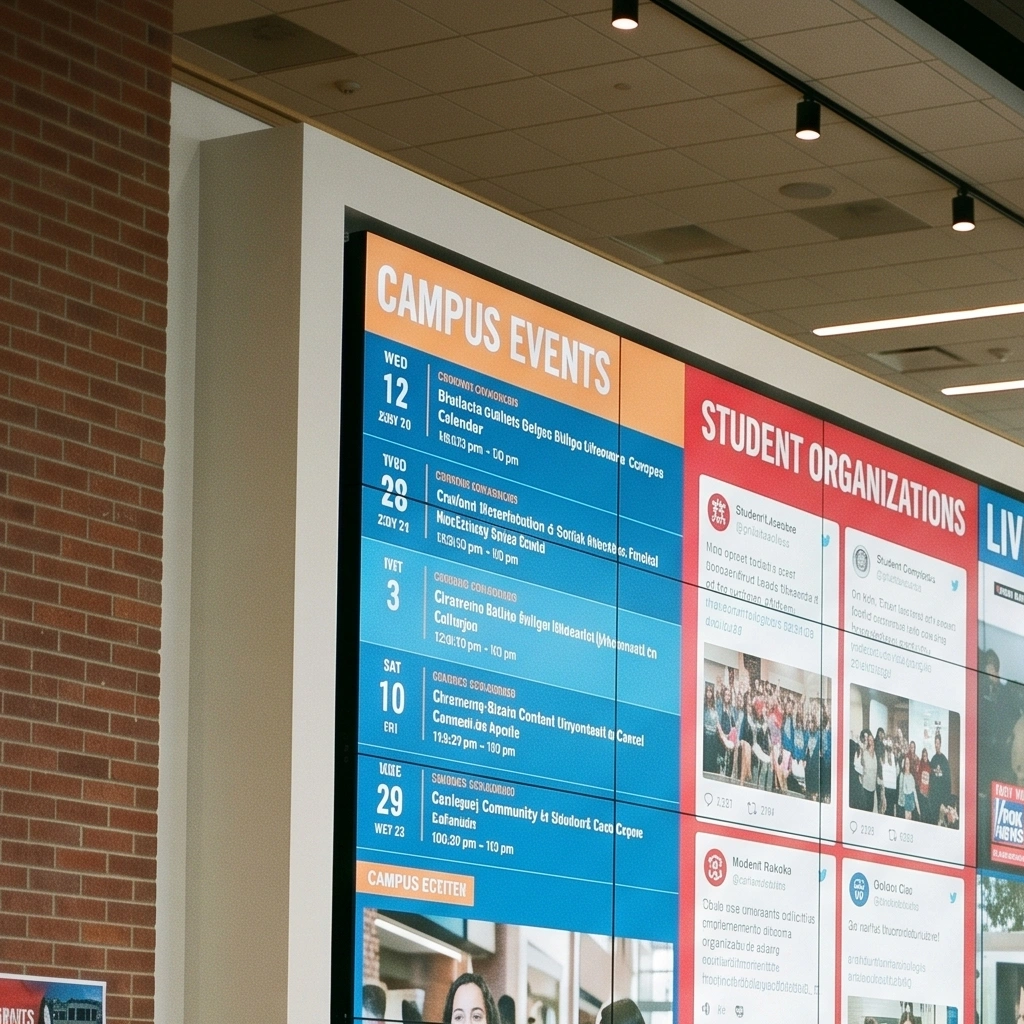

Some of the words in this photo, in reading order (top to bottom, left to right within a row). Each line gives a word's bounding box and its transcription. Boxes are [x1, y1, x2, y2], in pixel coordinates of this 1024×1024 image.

[377, 264, 501, 353] CAMPUS
[510, 315, 611, 396] EVENTS
[384, 350, 408, 370] WED
[383, 373, 409, 410] 12
[467, 444, 484, 455] pm
[505, 454, 519, 466] pm
[701, 399, 804, 474] STUDENT
[808, 442, 966, 537] ORGANIZATIONS
[381, 474, 408, 512] 28
[467, 544, 483, 556] pm
[505, 555, 519, 567] pm
[387, 579, 400, 611] 3
[467, 642, 482, 653] pm
[504, 650, 517, 661] pm
[383, 658, 402, 674] SAT
[379, 680, 405, 715] 10
[463, 739, 478, 750] pm
[502, 747, 516, 757] pm
[376, 783, 403, 817] 29
[482, 799, 538, 823] Community
[394, 826, 405, 838] 23
[462, 839, 477, 850] pm
[501, 845, 514, 855] pm
[367, 869, 420, 892] CAMPUS
